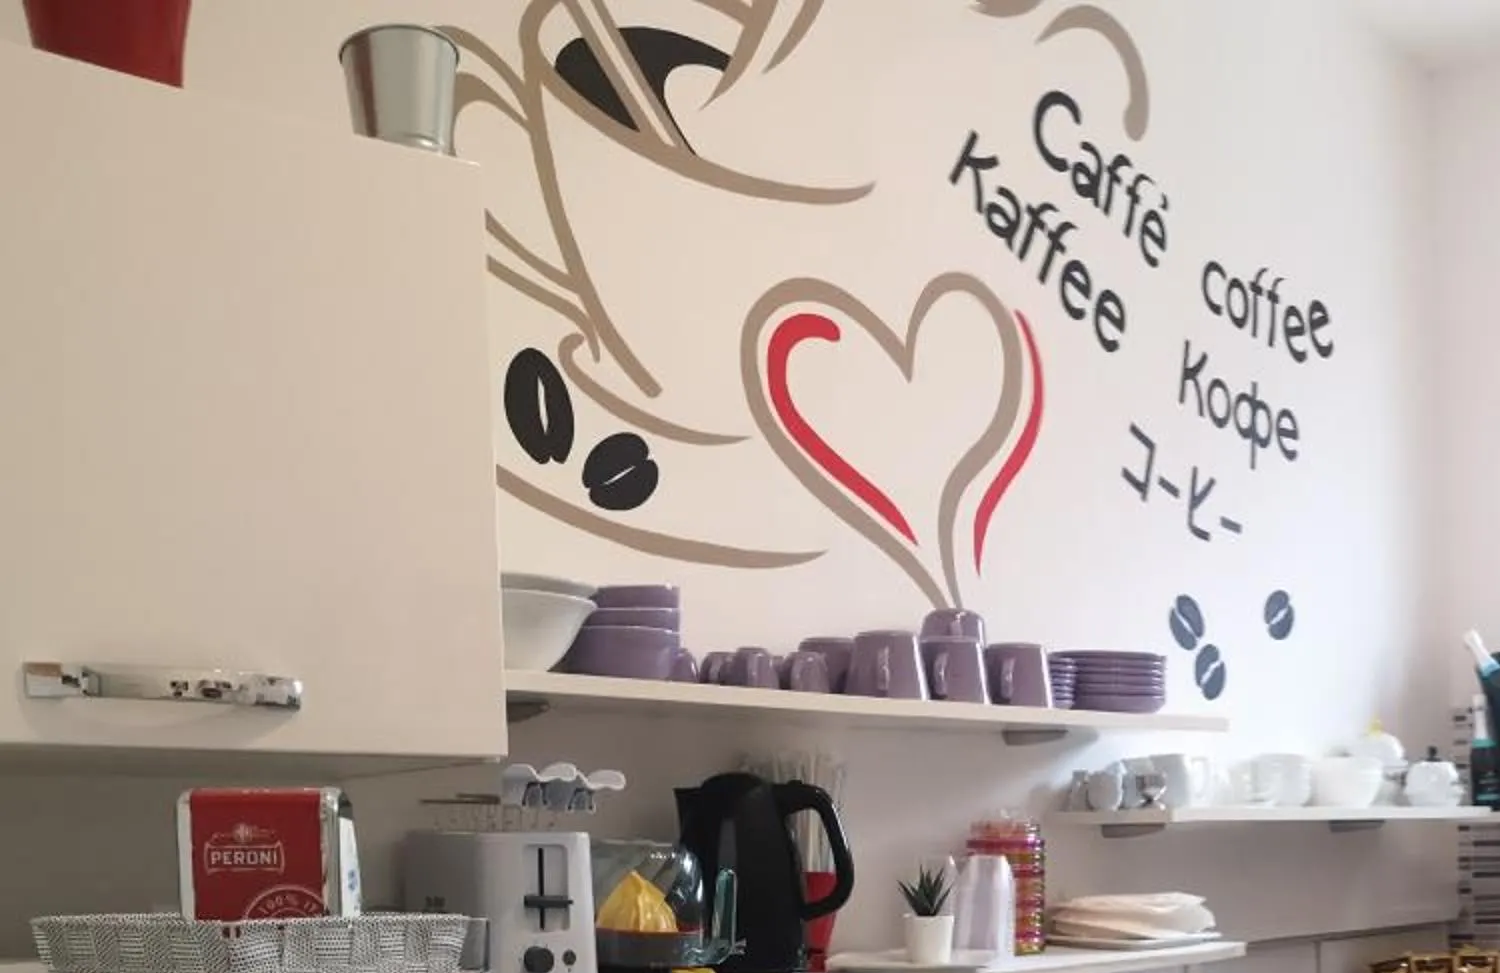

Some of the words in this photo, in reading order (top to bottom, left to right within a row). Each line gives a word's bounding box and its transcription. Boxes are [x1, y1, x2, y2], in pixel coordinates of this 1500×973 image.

[949, 129, 1126, 353] Kaffee
[1033, 91, 1169, 268] Caffè
[210, 850, 278, 866] PERONI
